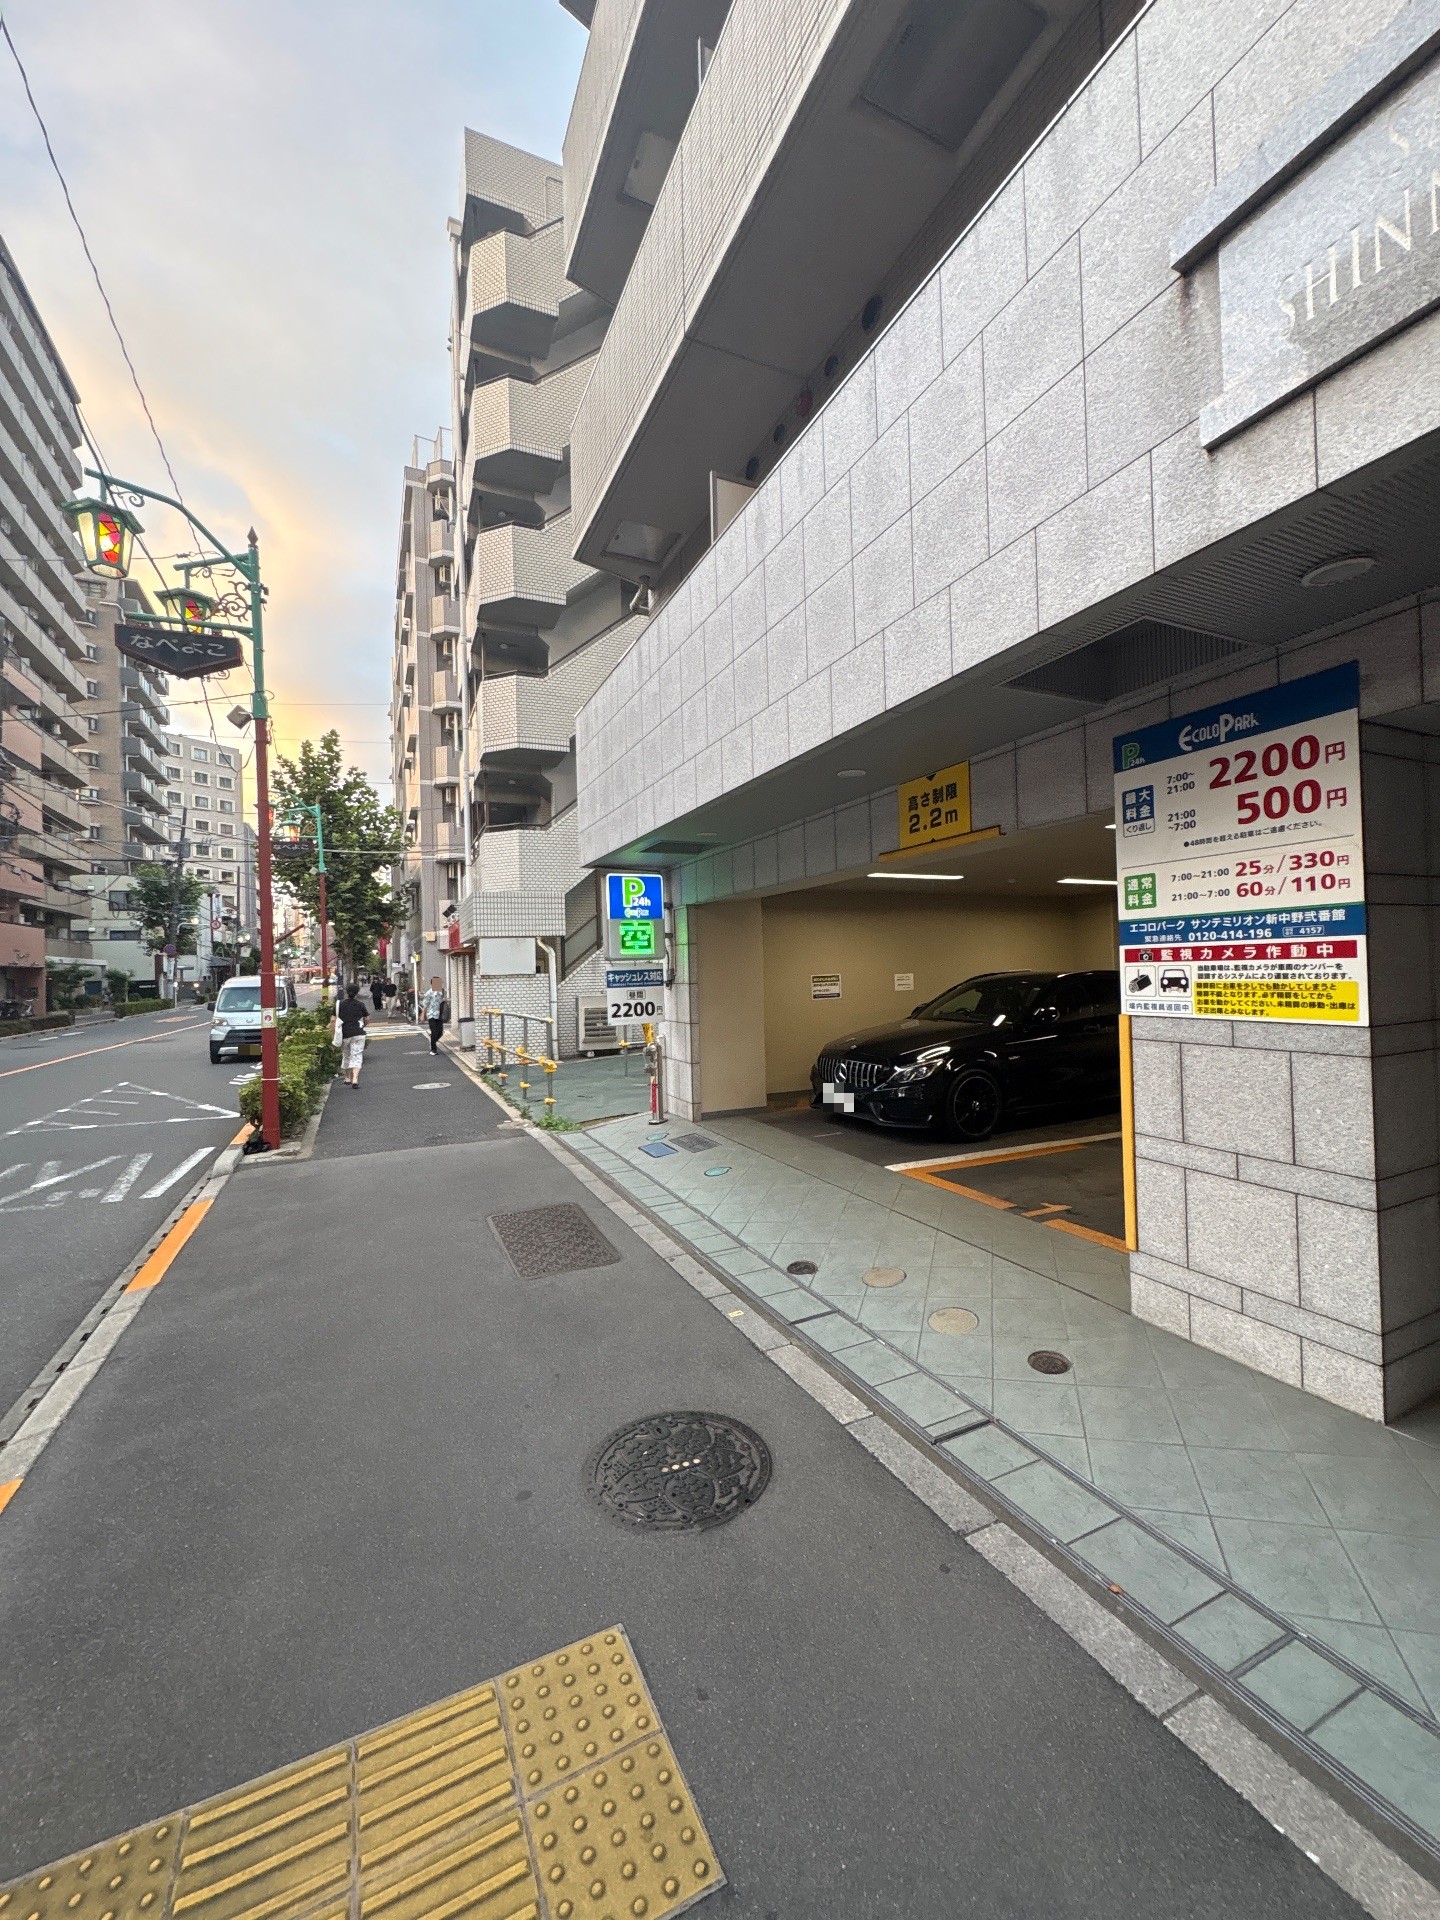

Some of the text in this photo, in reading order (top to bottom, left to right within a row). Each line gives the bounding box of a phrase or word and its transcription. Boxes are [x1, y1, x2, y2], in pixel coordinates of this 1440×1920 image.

[131, 634, 227, 656] なべよこ
[1166, 780, 1196, 795] 21:00
[908, 782, 958, 813] 高さ制限
[1125, 789, 1151, 805] 最大
[908, 806, 959, 835] 2.2m
[1125, 805, 1151, 821] 料金
[1167, 809, 1196, 823] 21:00
[1126, 822, 1152, 833] くり返し
[1127, 876, 1153, 891] 通常
[623, 877, 645, 907] P
[1128, 892, 1153, 907] 料金
[632, 896, 651, 907] 24h
[1130, 920, 1186, 933] エコロパーク
[1188, 928, 1273, 942] 0120-414-196
[1161, 943, 1335, 961] 監視カメラ作動中
[608, 971, 663, 983] キャッシュレス対応
